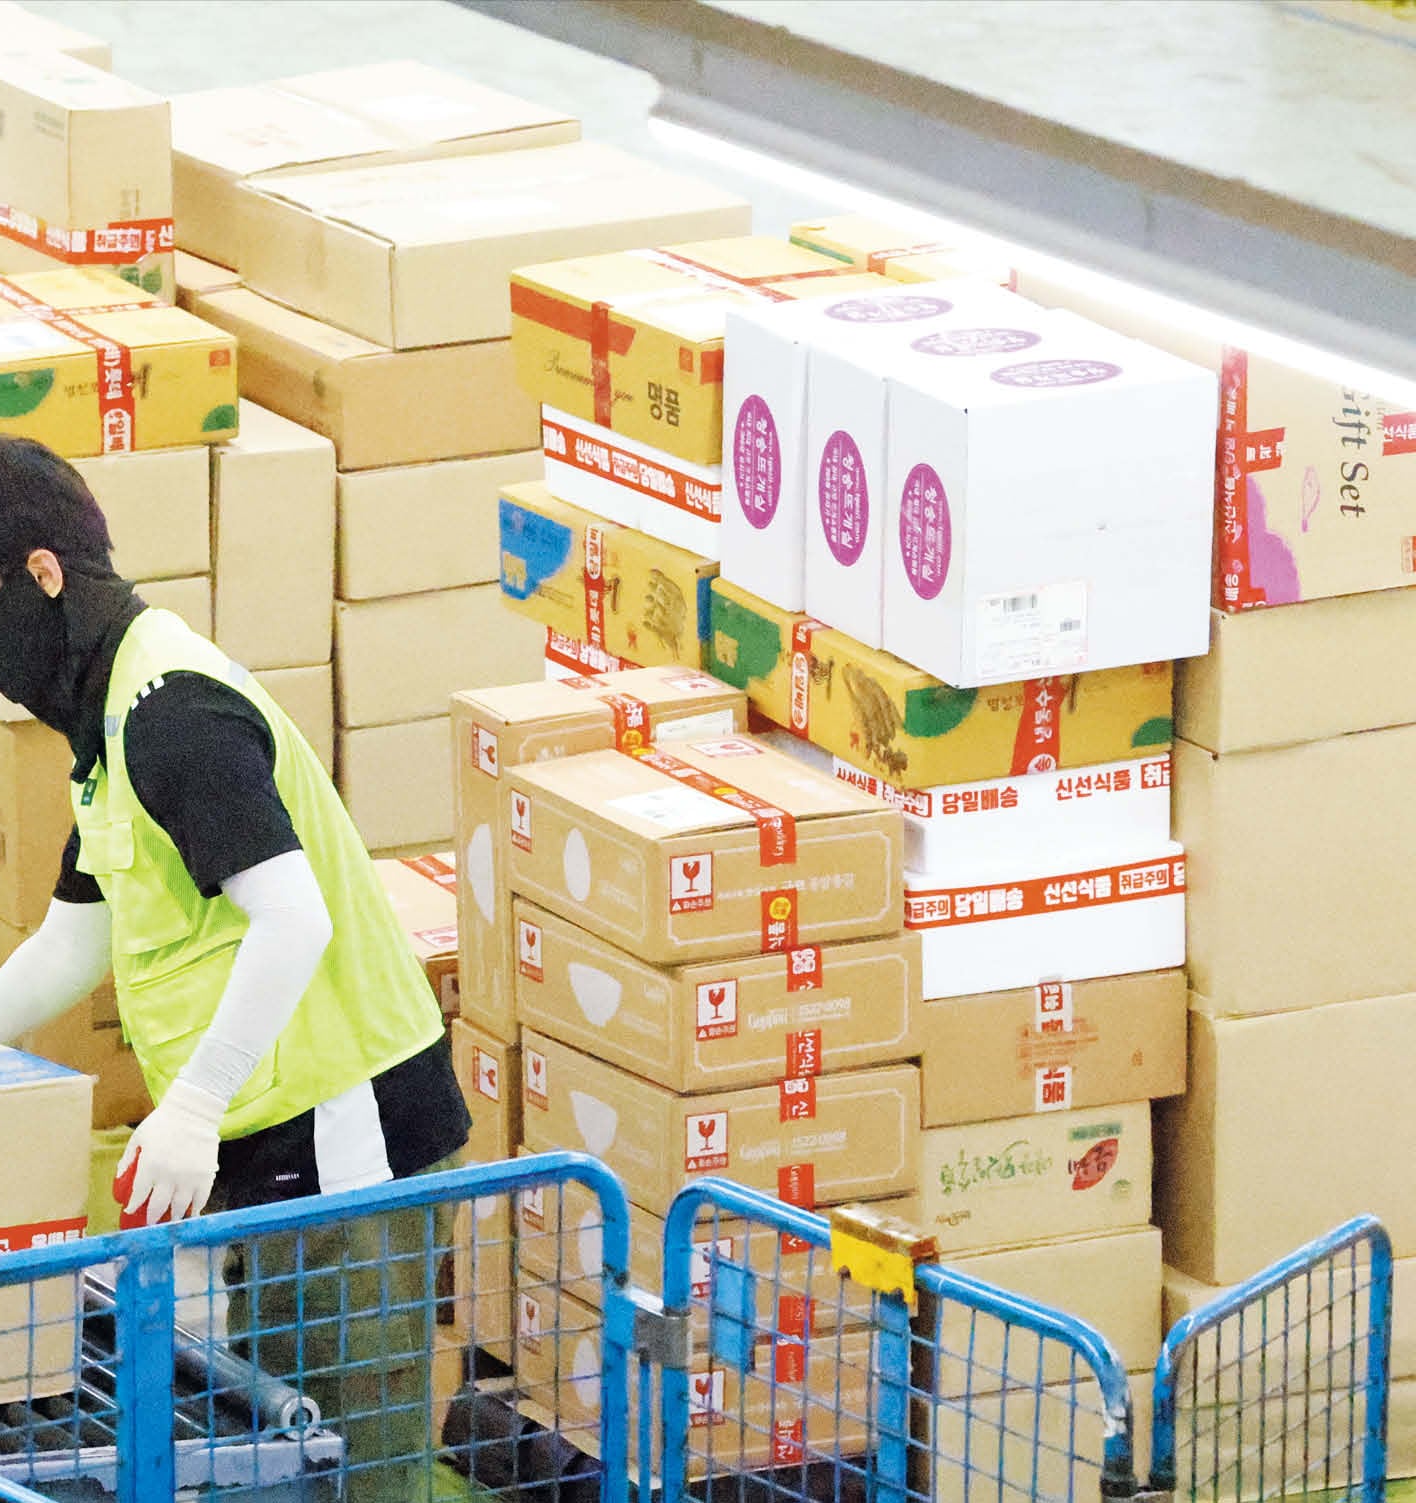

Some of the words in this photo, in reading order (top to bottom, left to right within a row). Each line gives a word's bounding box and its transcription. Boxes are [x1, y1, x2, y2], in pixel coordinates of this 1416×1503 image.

[647, 382, 681, 428] 명품
[1333, 386, 1371, 450] ift
[1340, 462, 1369, 518] Set
[942, 786, 1018, 815] 당일배송
[1056, 769, 1131, 802] 신선식품
[955, 888, 1024, 918] 당일배송
[1043, 875, 1112, 906] 신선식품
[1120, 866, 1169, 893] 취급주의
